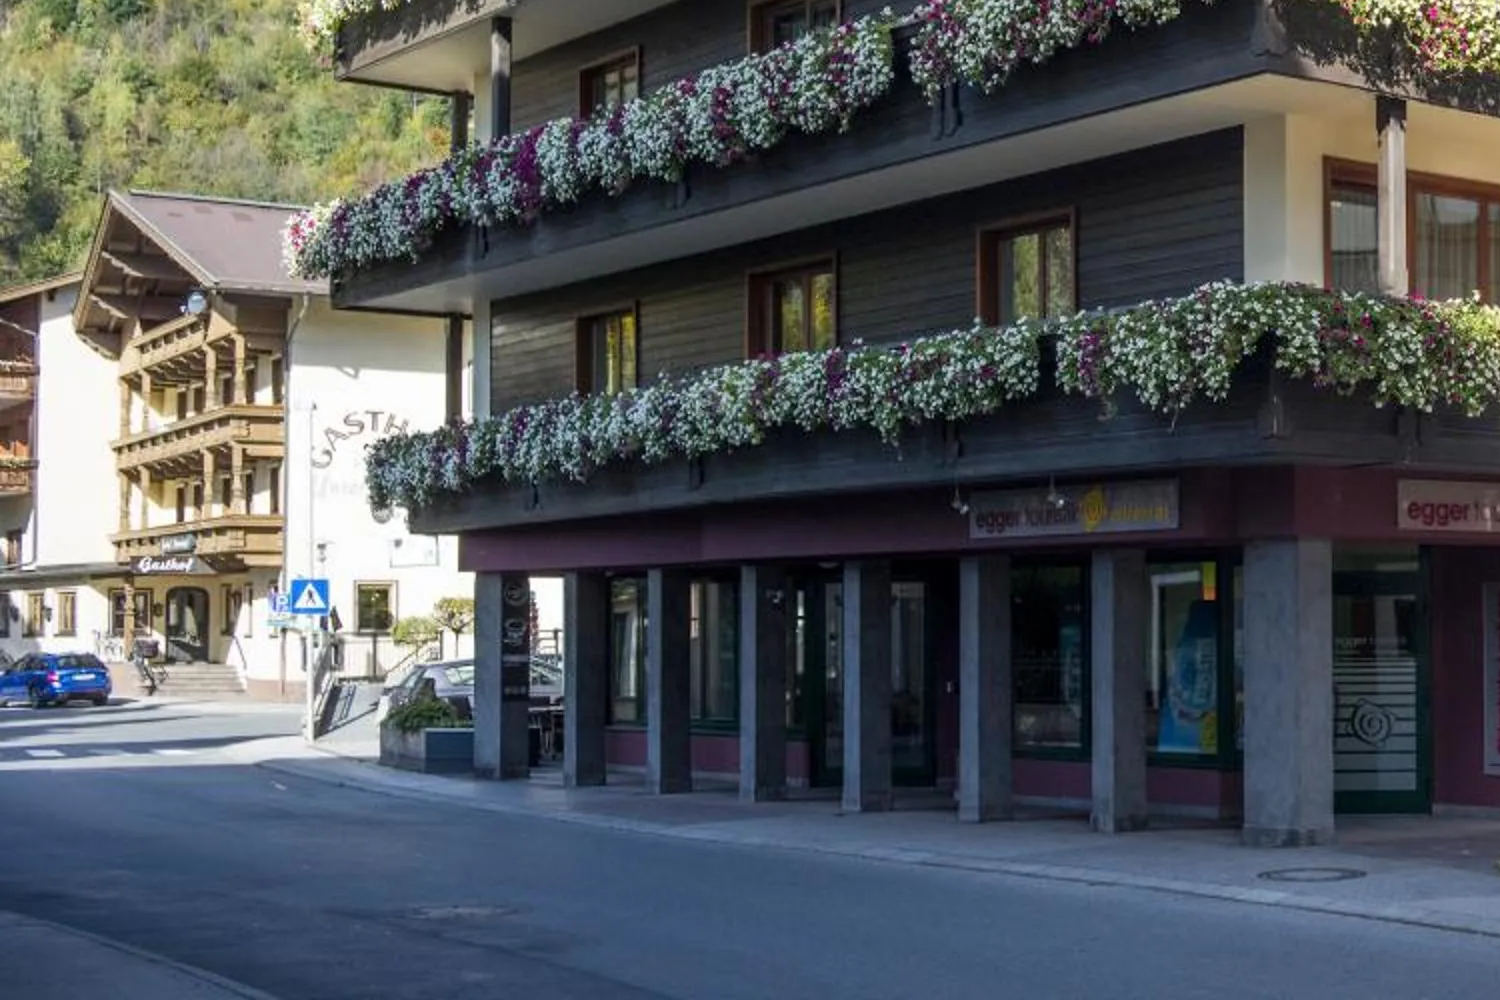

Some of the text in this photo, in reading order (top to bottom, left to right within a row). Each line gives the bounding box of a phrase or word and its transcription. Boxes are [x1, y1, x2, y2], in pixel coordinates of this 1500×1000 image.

[311, 410, 409, 469] GASTH
[976, 510, 1020, 534] egger
[1407, 500, 1470, 527] egger
[138, 556, 195, 573] Gasthof
